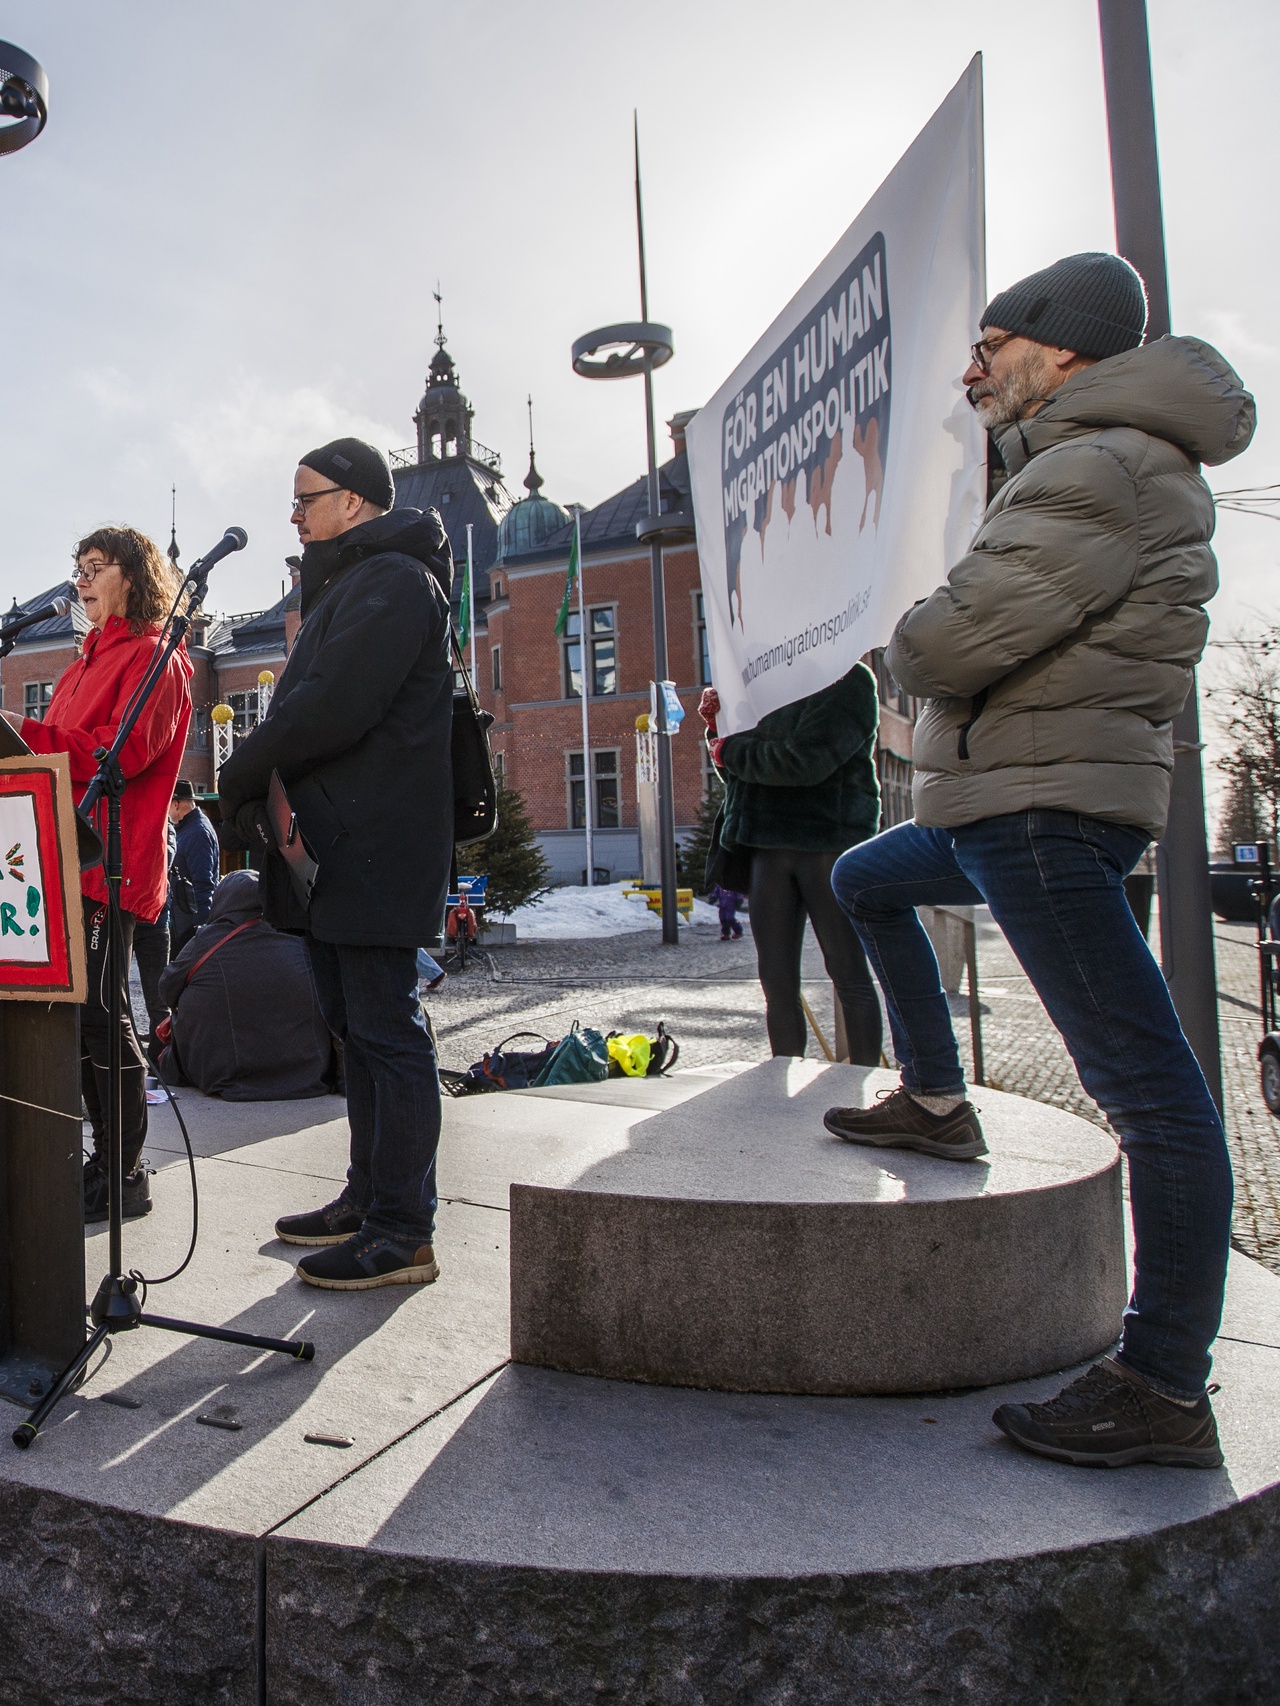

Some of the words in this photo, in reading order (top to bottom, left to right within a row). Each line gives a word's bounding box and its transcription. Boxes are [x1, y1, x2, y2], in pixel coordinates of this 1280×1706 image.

[723, 335, 890, 528] MIGRATIONSPOLITIK
[724, 391, 757, 470] FÖR
[762, 357, 788, 434] EN
[794, 251, 884, 403] HUMAN
